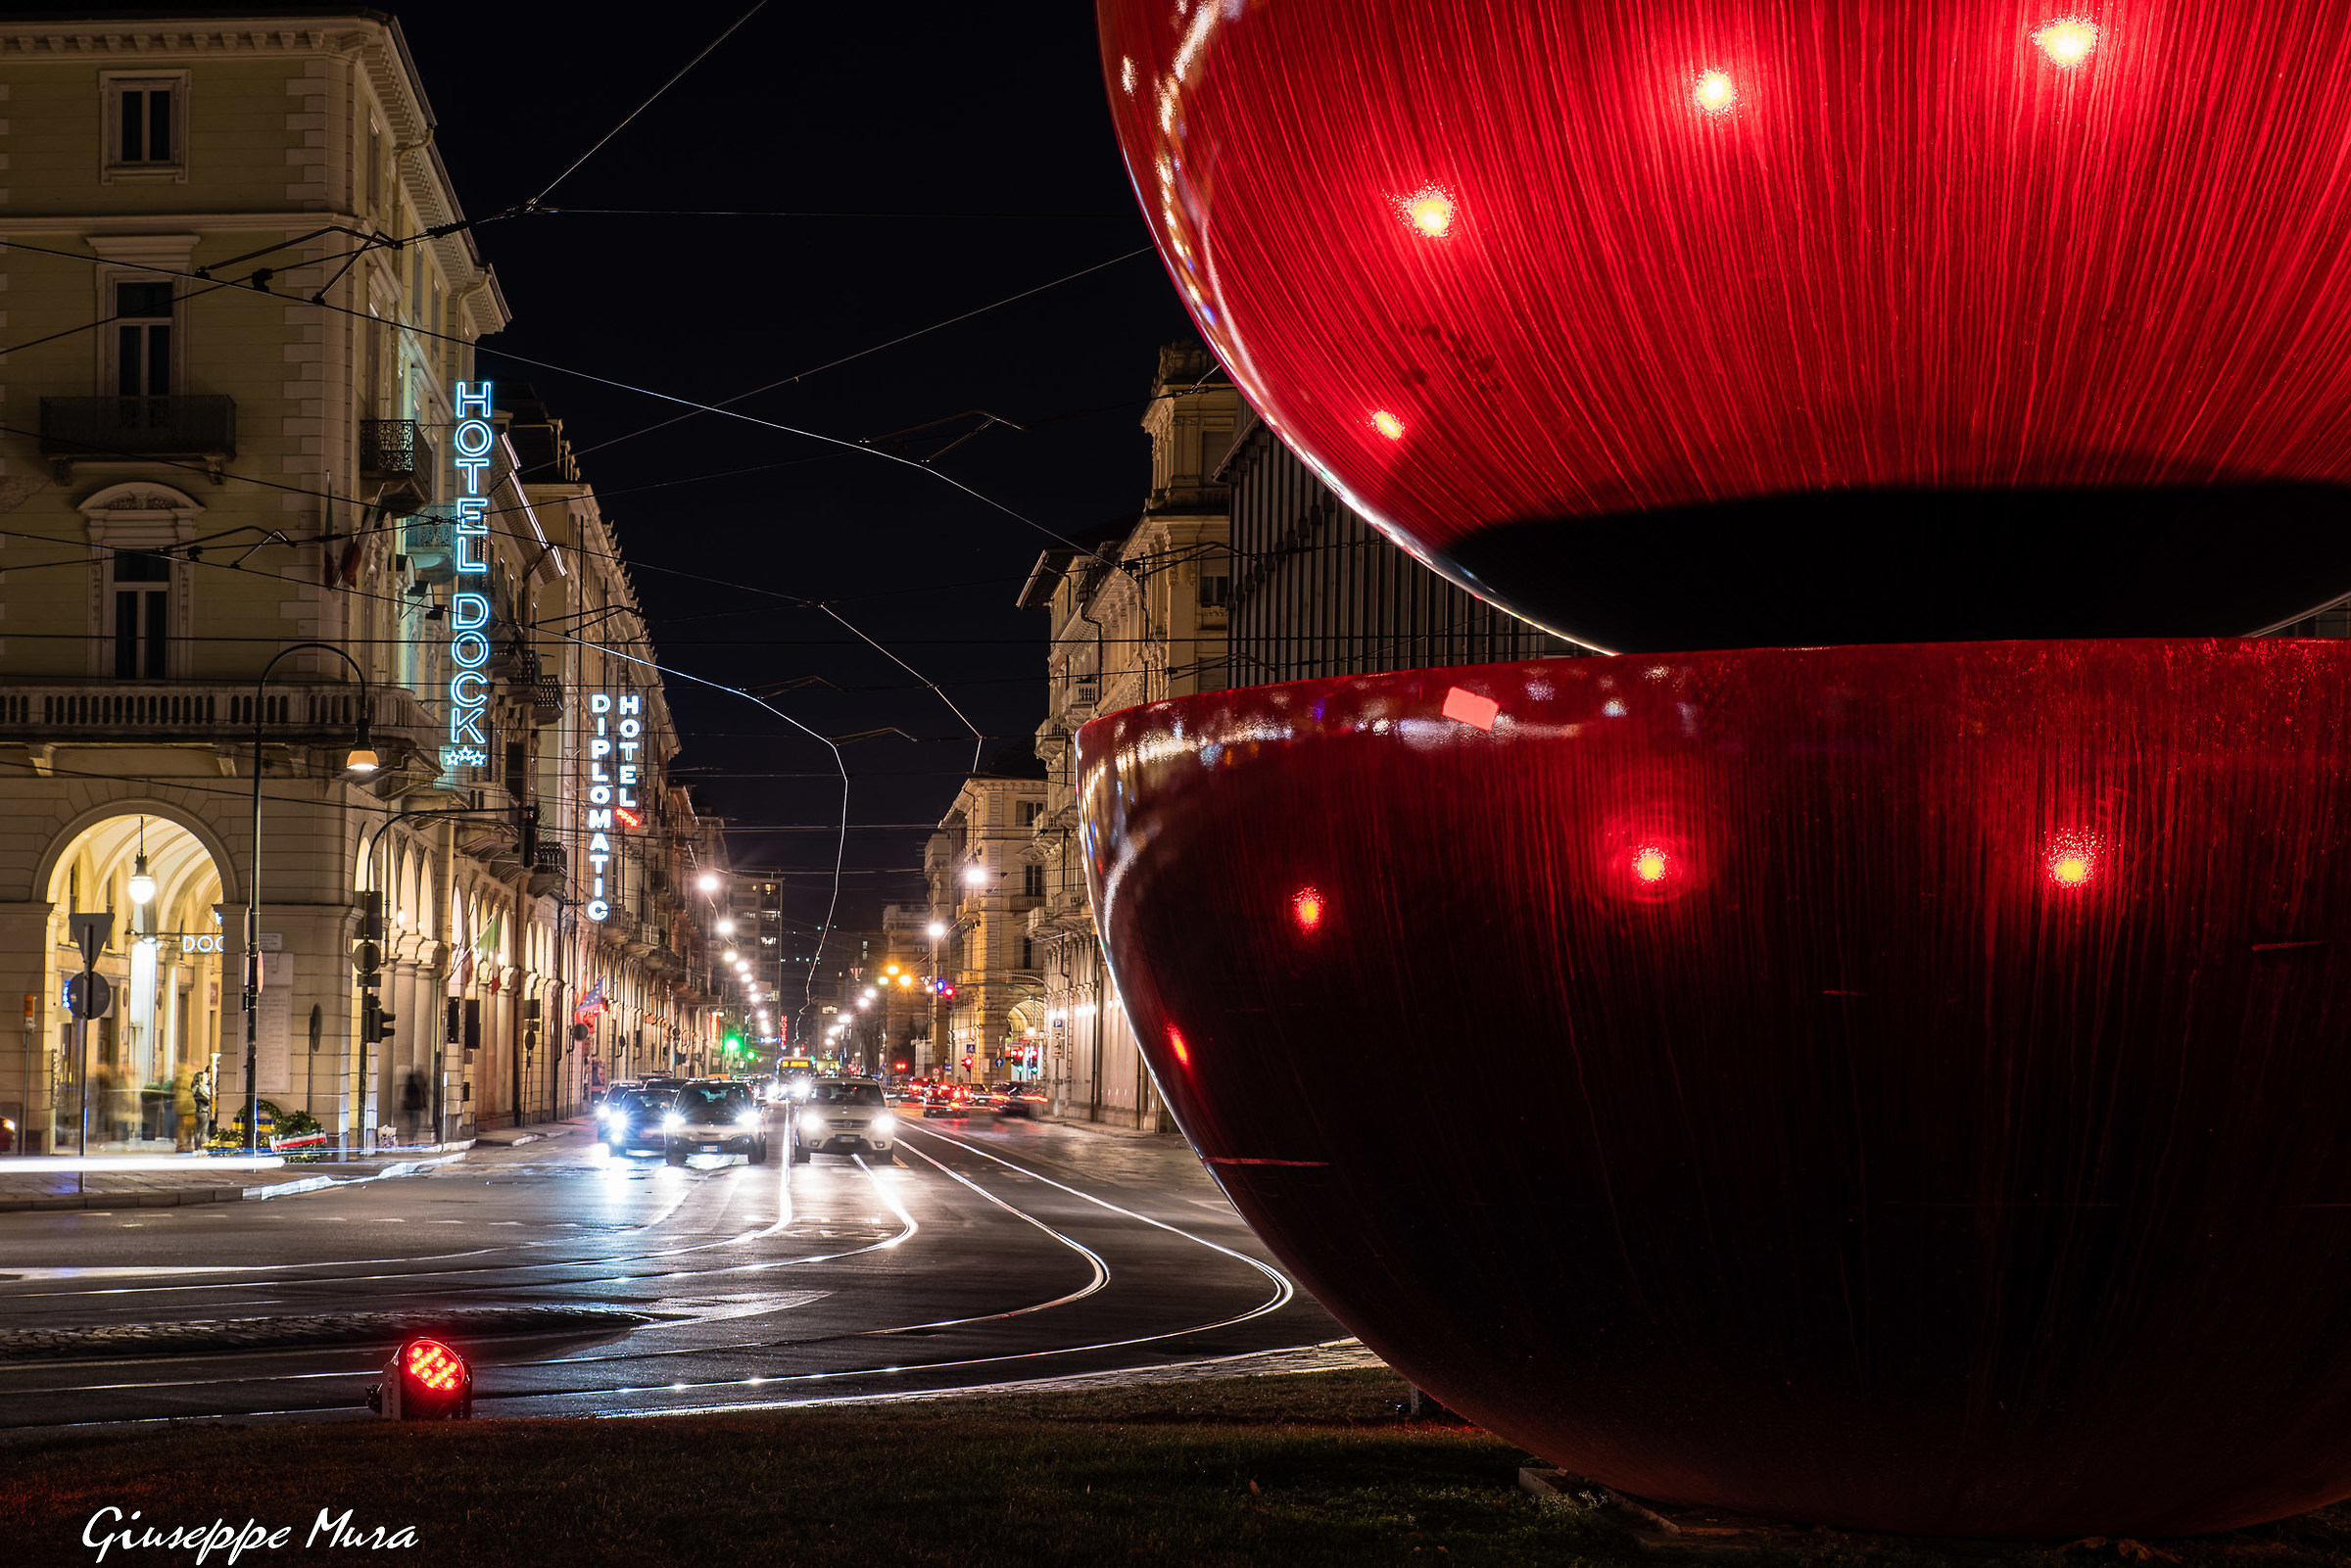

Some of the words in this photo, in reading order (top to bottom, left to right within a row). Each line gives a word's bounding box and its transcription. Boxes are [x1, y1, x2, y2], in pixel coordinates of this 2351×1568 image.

[455, 381, 493, 572] HOTEL
[450, 594, 490, 744] DOCK
[619, 695, 640, 807] HOTEL
[588, 693, 612, 921] DIPLOMATIC
